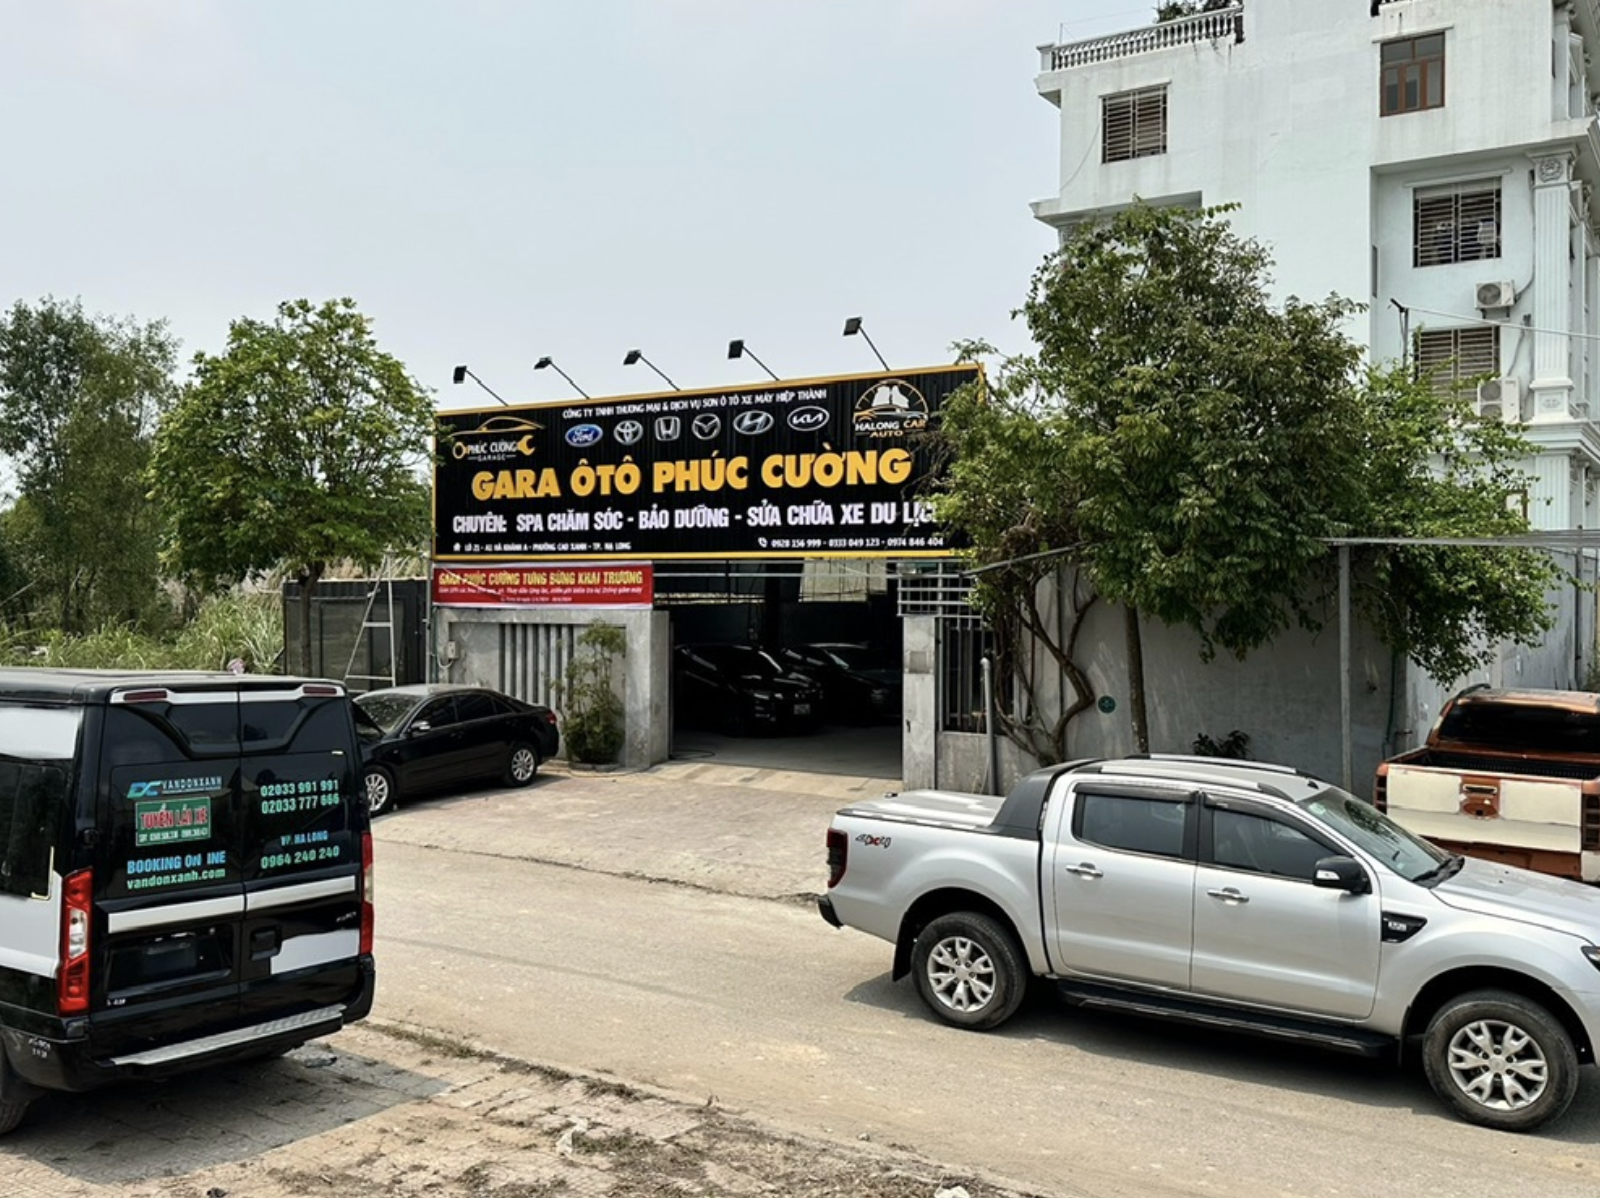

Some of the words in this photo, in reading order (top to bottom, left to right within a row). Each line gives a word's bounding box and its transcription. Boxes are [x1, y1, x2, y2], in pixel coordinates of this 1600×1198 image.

[562, 408, 582, 419] CÔNG
[583, 407, 593, 417] TY
[720, 394, 727, 406] Ô
[728, 394, 739, 406] TÔ
[741, 394, 753, 405] XE
[754, 391, 774, 404] MÁY
[797, 388, 827, 401] THÀNH
[855, 421, 900, 431] HALONG
[903, 419, 926, 428] CAR
[870, 430, 903, 438] AUTO
[471, 468, 561, 501] GARA
[570, 455, 641, 497] ÔTÔ
[653, 450, 748, 493] PHÚC
[761, 442, 912, 488] CƯỜNG
[453, 511, 507, 533] CHUYÊN:
[516, 513, 544, 532] SPA
[548, 509, 589, 531] CHĂM
[594, 508, 624, 530] SÓC
[638, 503, 668, 530] BẢO
[674, 504, 729, 529] DƯỠNG
[747, 499, 782, 527] SỬA
[787, 500, 834, 526] CHỮA
[841, 504, 864, 525] XE
[871, 502, 896, 524] DU
[577, 571, 600, 585] KHAI
[161, 776, 222, 790] VANDONXANH
[261, 783, 296, 797] 02033
[298, 781, 317, 793] 991
[320, 780, 339, 791] 991
[262, 798, 297, 814] 02033
[298, 795, 318, 810] 777
[139, 803, 174, 830] TUYỂN
[294, 849, 317, 863] 240
[319, 845, 340, 859] 240
[127, 856, 182, 874] BOOKING
[127, 868, 226, 890] vandonxanh.com
